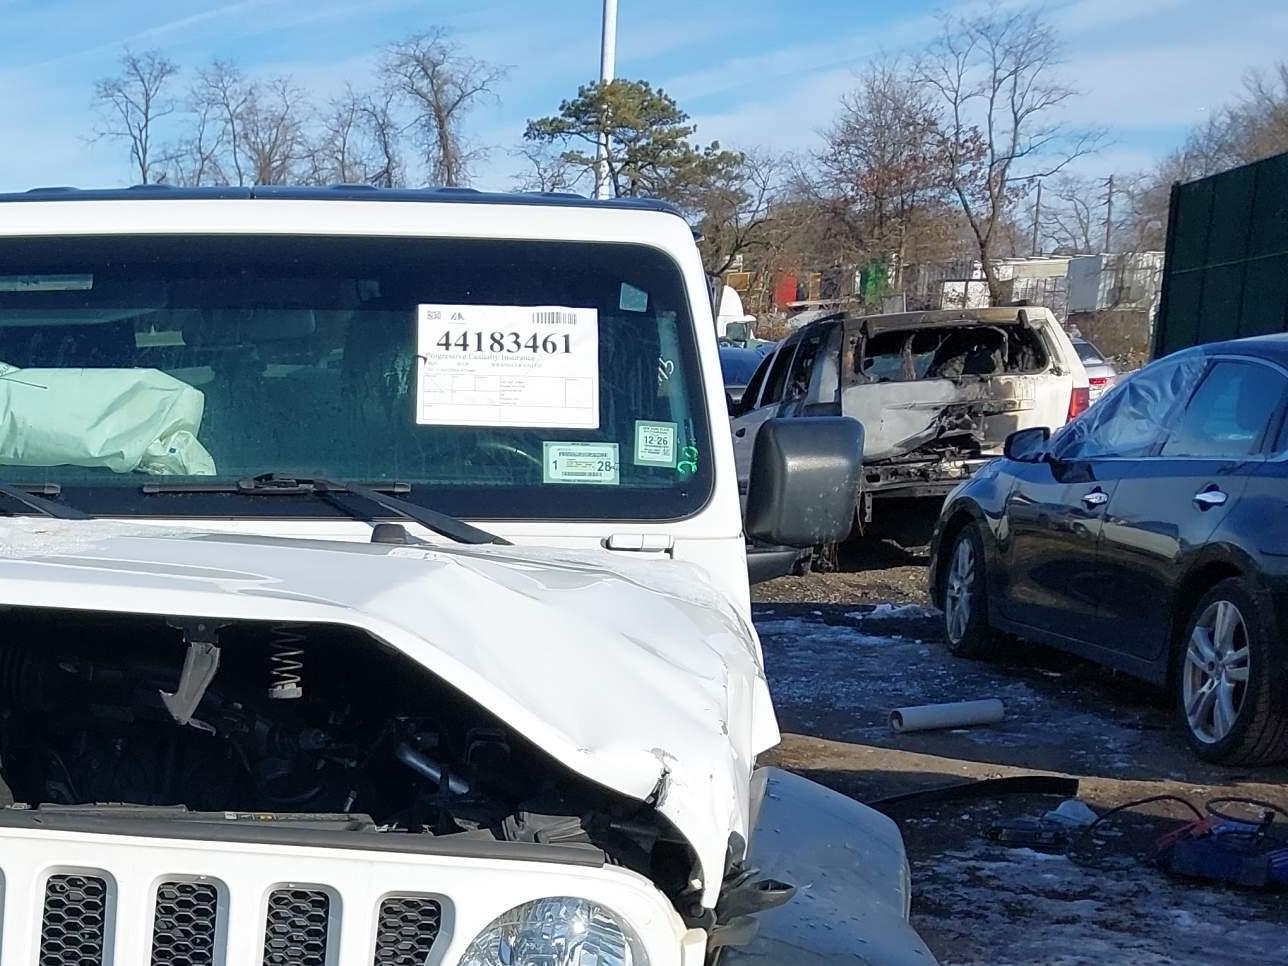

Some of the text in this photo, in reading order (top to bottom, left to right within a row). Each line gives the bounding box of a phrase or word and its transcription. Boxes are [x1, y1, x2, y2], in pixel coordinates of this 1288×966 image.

[436, 330, 574, 354] 44183461
[425, 352, 536, 362] Progressive Casualty Insurance
[597, 461, 612, 472] 28
